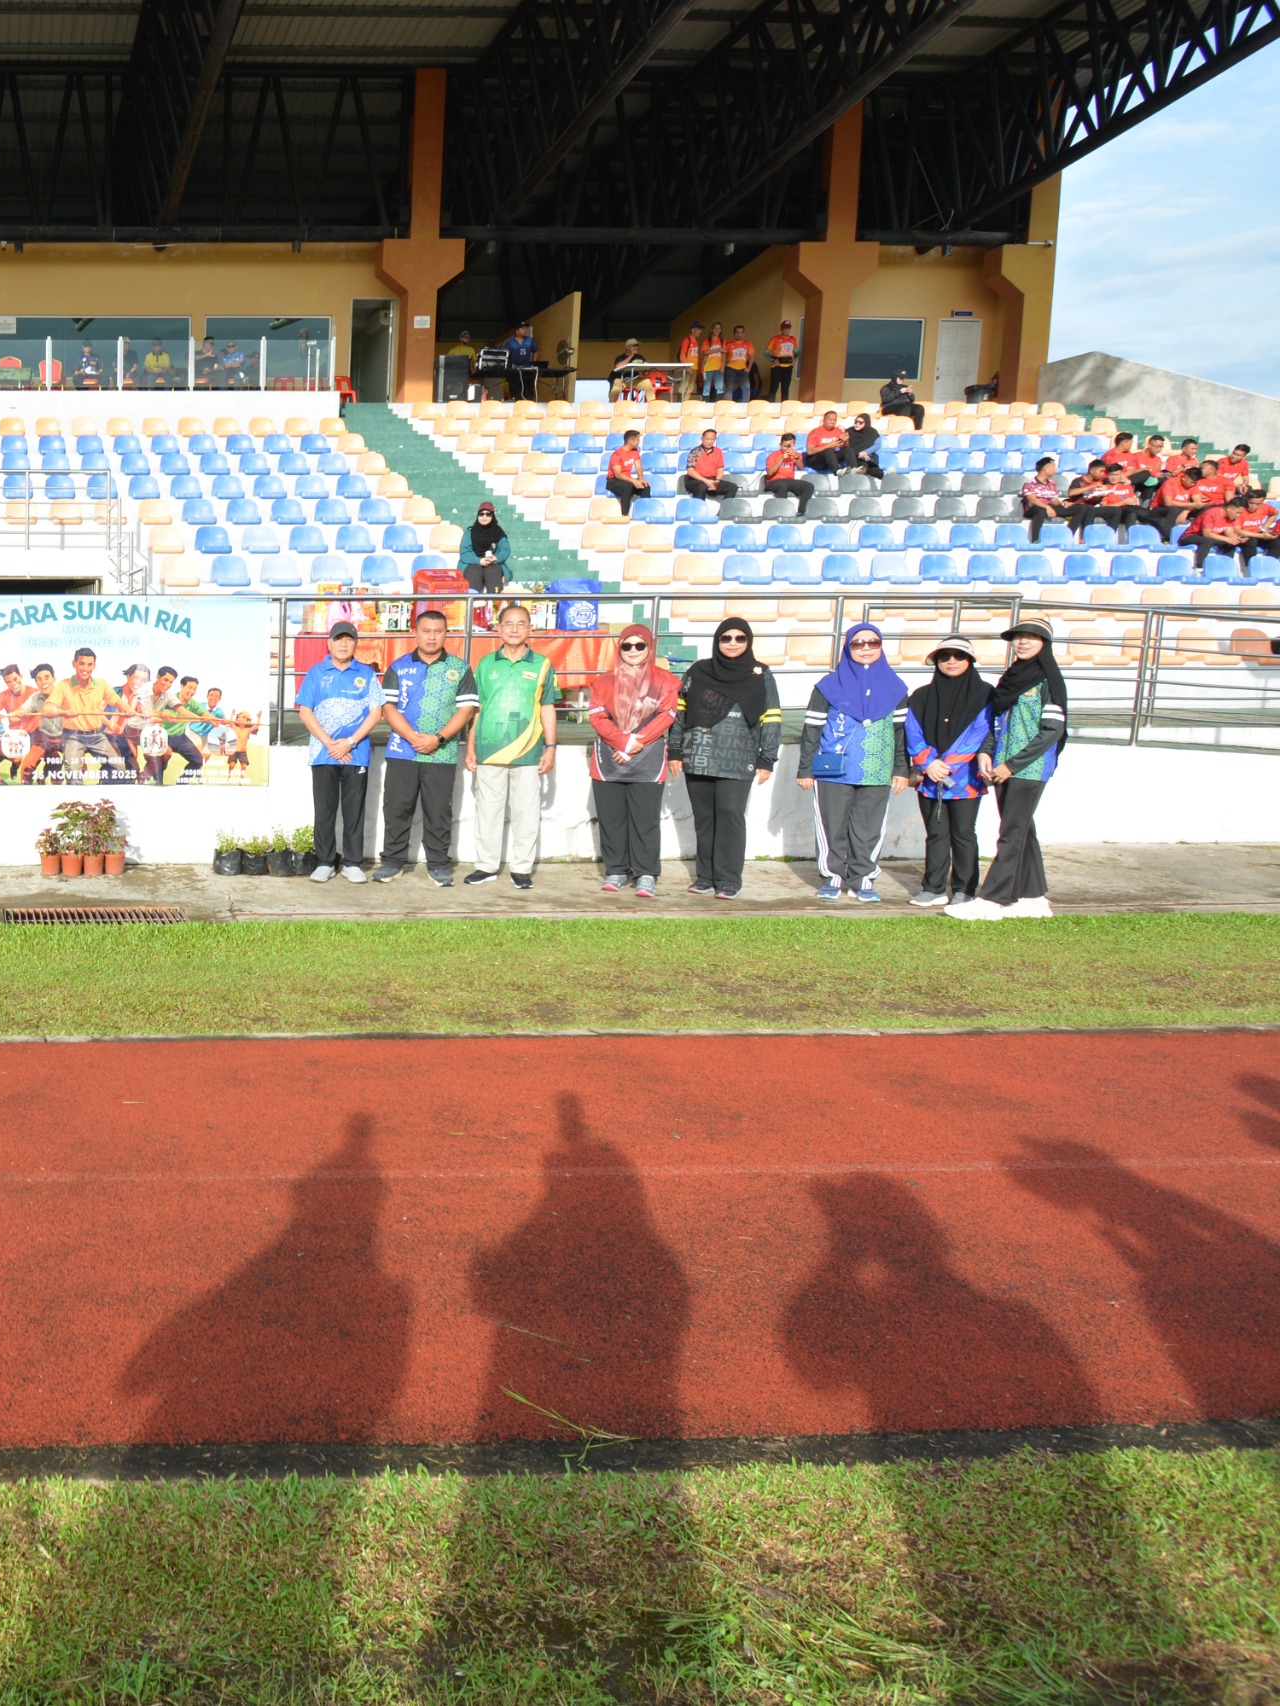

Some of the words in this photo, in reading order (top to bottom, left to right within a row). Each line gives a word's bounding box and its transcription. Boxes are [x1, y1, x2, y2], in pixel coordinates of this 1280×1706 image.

[63, 600, 150, 625] SUKAN
[154, 609, 192, 639] RIA
[62, 623, 106, 635] MUKIM
[21, 636, 62, 648] PEKAN
[65, 636, 115, 648] TUTONG
[47, 769, 109, 780] NOVEMBER
[111, 769, 137, 780] 2025
